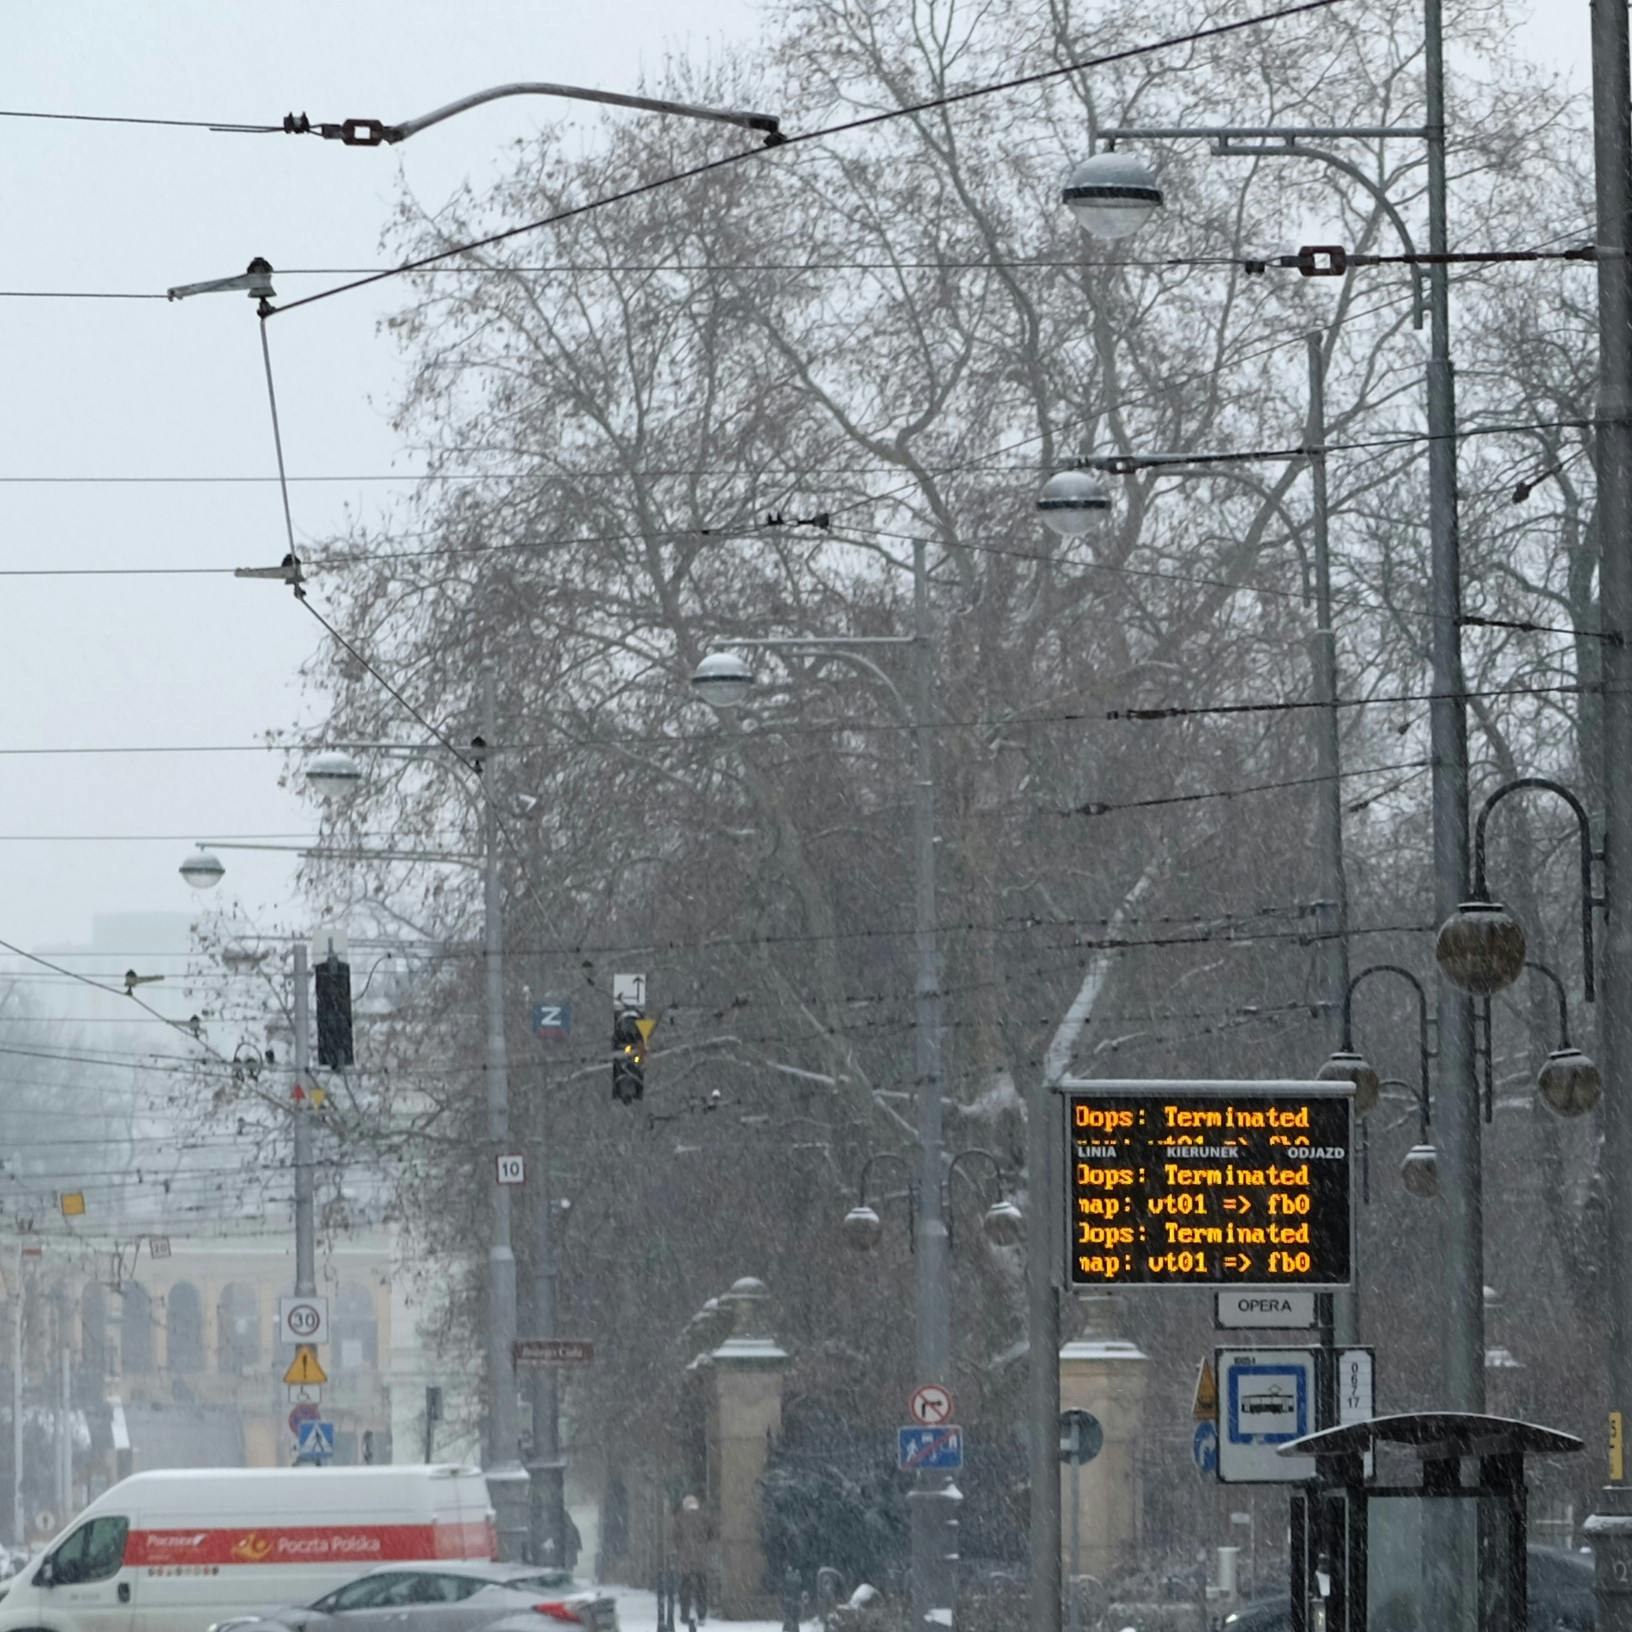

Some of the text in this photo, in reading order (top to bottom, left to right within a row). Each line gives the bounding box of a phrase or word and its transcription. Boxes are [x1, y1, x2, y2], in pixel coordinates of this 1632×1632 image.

[1075, 1106, 1310, 1132] Oops: Terminated
[1077, 1147, 1346, 1160] LINIA KIERUNEK ODJAZD
[502, 1161, 520, 1177] 10
[1164, 1164, 1310, 1186] Terminated
[1164, 1222, 1310, 1244] Terminated
[1238, 1299, 1293, 1313] OPERA
[293, 1311, 316, 1328] 30
[1348, 1397, 1360, 1409] 17
[277, 1535, 381, 1553] Poczta Polska
